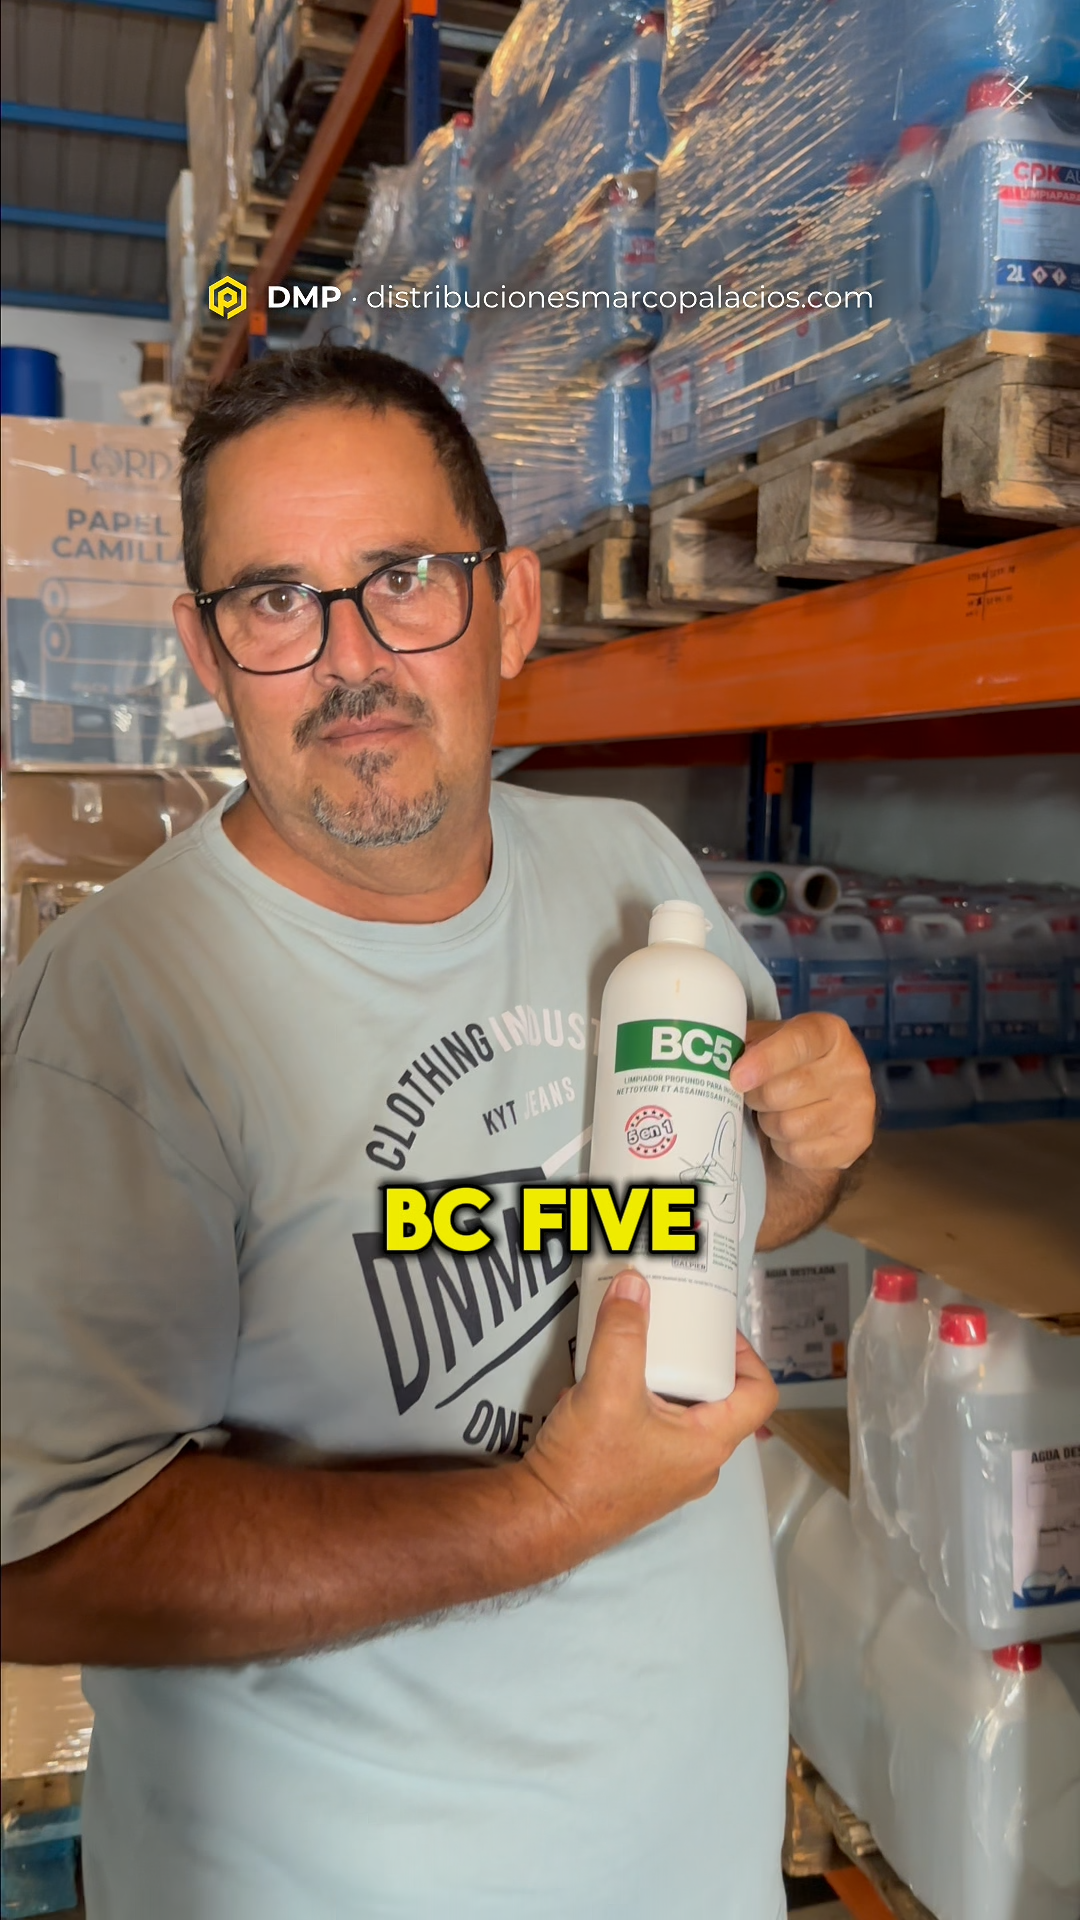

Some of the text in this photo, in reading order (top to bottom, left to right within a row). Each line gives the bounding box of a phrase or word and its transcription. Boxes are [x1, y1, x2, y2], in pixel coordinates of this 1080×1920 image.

[68, 443, 173, 482] LORD
[67, 508, 171, 537] PAPEL
[651, 1026, 733, 1072] BC5
[365, 1022, 495, 1172] CLOTHING
[616, 1085, 658, 1096] NETTOYEUR
[661, 1085, 671, 1093] ET
[673, 1085, 727, 1103] ASSAINISSANT
[624, 1074, 663, 1085] LIMPIADOR
[664, 1074, 705, 1087] PROFUNDO
[706, 1080, 722, 1091] PARA
[482, 1076, 576, 1136] KYT JEANS
[626, 1119, 674, 1145] 5 en 1
[462, 1398, 533, 1458] ONE
[1031, 1448, 1060, 1464] AGUA
